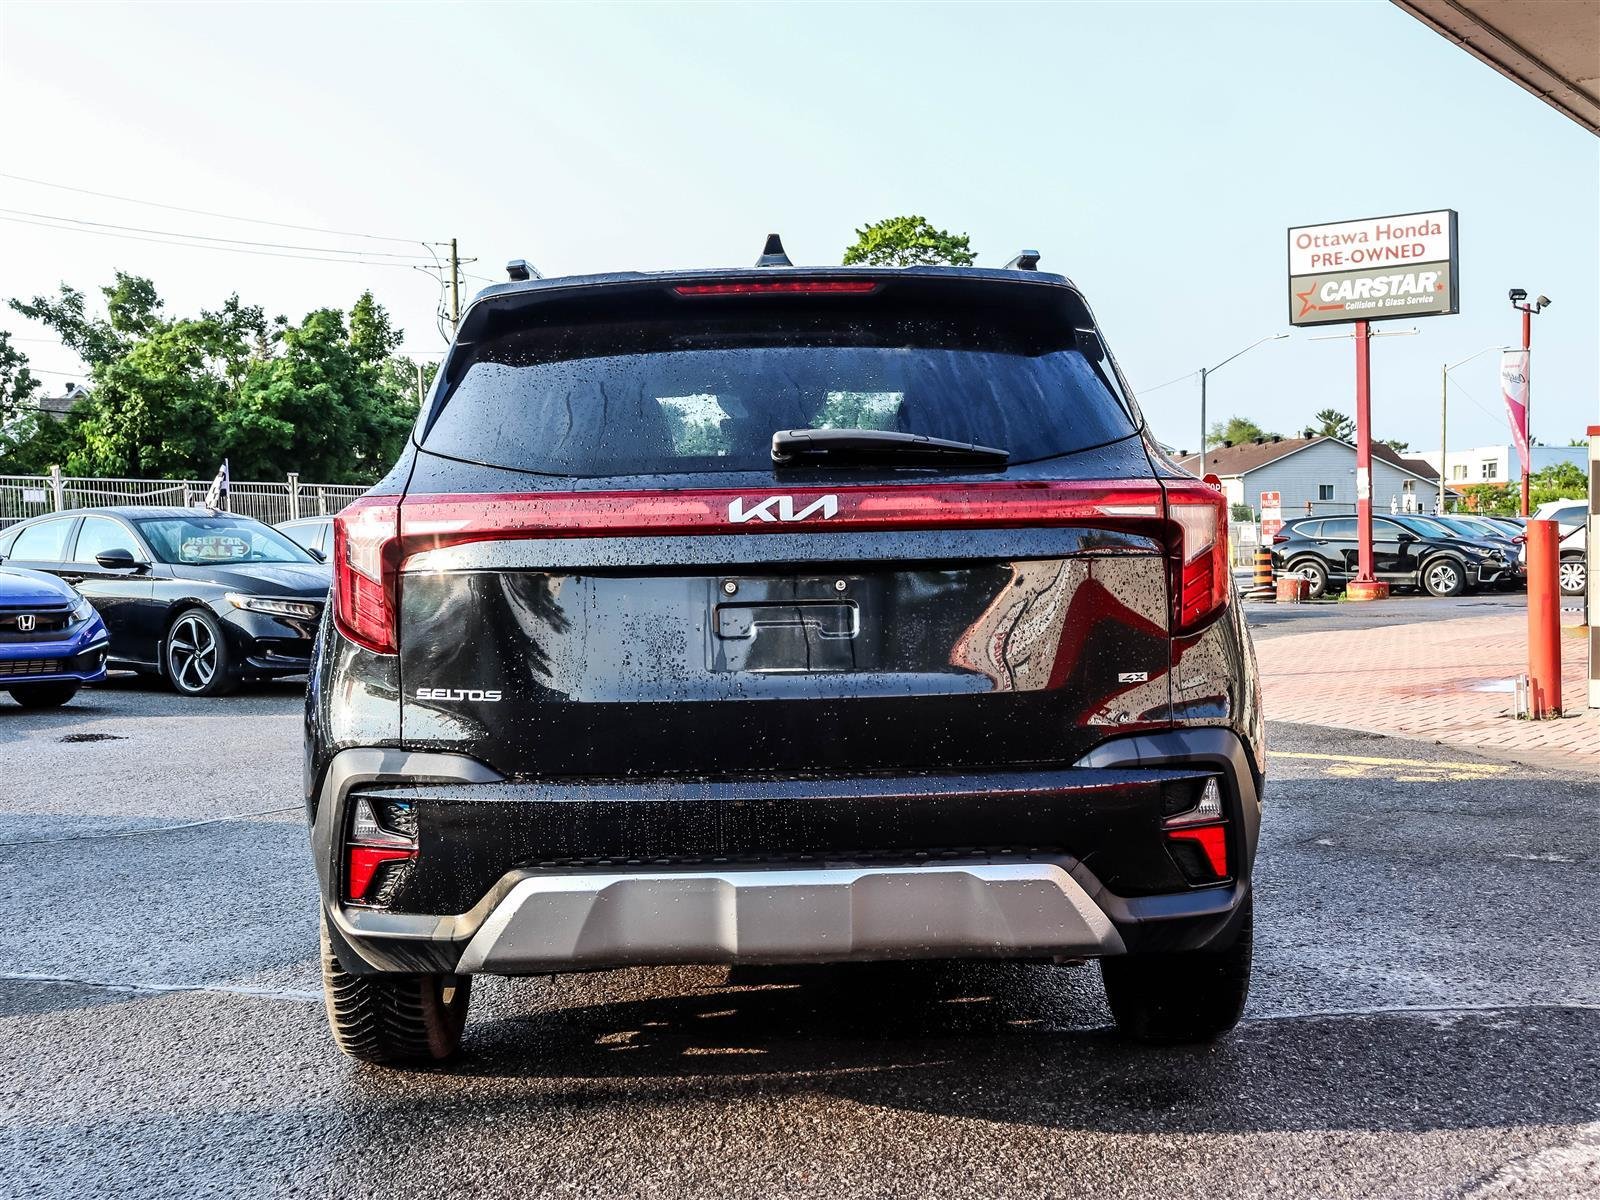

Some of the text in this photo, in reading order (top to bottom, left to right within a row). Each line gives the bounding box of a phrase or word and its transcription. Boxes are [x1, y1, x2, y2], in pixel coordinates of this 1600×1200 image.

[1296, 219, 1442, 249] Ottawa Honda
[1311, 243, 1425, 267] PRE-OWNED
[1320, 271, 1438, 302] CARSTAR
[1345, 295, 1434, 310] Collision & Glass Service
[729, 495, 838, 522] KIA
[187, 536, 242, 546] USED CAR
[183, 545, 245, 559] SALE
[416, 688, 502, 702] SELTOS
